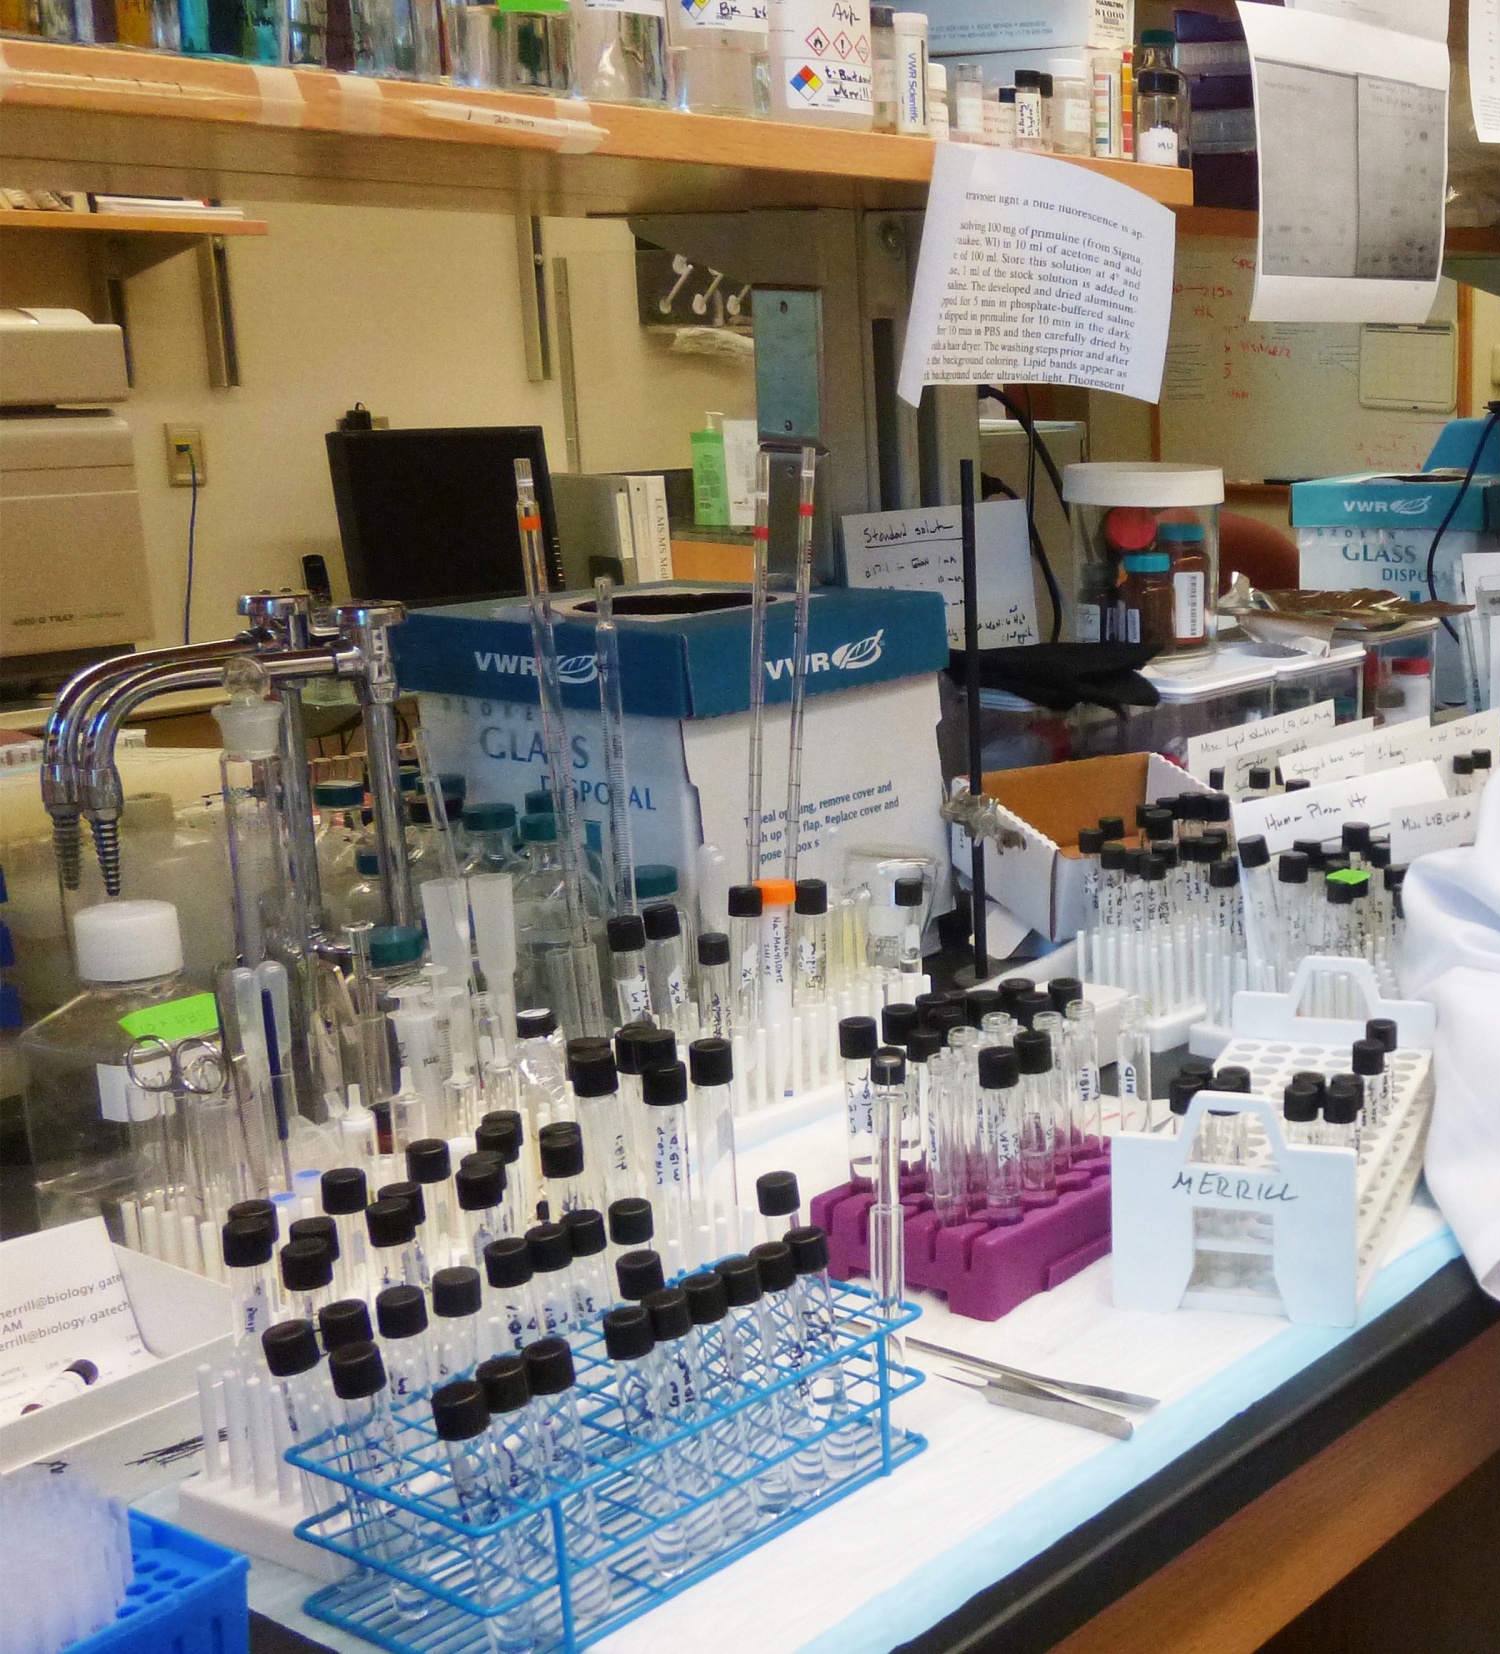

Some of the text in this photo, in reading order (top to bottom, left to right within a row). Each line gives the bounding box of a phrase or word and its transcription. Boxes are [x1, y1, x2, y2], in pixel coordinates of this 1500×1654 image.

[907, 52, 918, 123] VWR Scientific
[960, 221, 986, 234] solving
[988, 222, 1001, 232] 100
[1003, 226, 1016, 237] mg
[1019, 226, 1030, 235] of
[1031, 229, 1080, 244] primuline
[1083, 237, 1110, 253] (from
[956, 235, 982, 246] aukee,
[1003, 239, 1011, 248] in
[1016, 240, 1026, 249] 10
[1030, 242, 1042, 251] ml
[1046, 245, 1058, 254] of
[1061, 248, 1099, 263] acetone
[1103, 259, 1121, 270] and
[1124, 265, 1142, 277] add
[971, 251, 983, 261] 100
[1002, 253, 1025, 265] Store
[1029, 256, 1047, 267] this
[1051, 260, 1091, 275] solution
[1096, 270, 1105, 278] at
[1122, 278, 1141, 290] and
[971, 281, 986, 291] The
[988, 282, 1031, 296] developed
[1034, 287, 1051, 297] and
[1055, 287, 1081, 301] dried
[982, 267, 992, 277] of
[994, 267, 1006, 278] the
[1009, 269, 1034, 280] stock
[1038, 272, 1078, 286] solution
[1082, 280, 1090, 289] is
[1095, 284, 1125, 298] added
[1129, 292, 1139, 302] to
[944, 310, 968, 323] dipped
[970, 312, 977, 321] in
[980, 312, 1018, 324] primuline
[1021, 314, 1034, 324] for
[1038, 315, 1049, 326] 10
[1052, 317, 1071, 328] min
[1075, 321, 1084, 330] in
[1089, 323, 1104, 334] the
[960, 295, 970, 306] for
[981, 297, 995, 307] min
[999, 298, 1006, 307] in
[1010, 298, 1103, 319] phosphate-buffered
[1107, 314, 1136, 328] saline
[984, 326, 1000, 337] PBS
[1003, 327, 1019, 338] and
[1022, 328, 1041, 339] then
[1045, 332, 1086, 346] carefully
[1090, 337, 1116, 349] dried
[1120, 342, 1132, 355] by
[984, 341, 999, 351] The
[1001, 341, 1034, 355] washing
[1035, 346, 1058, 357] steps
[1059, 347, 1084, 358] prior
[1085, 351, 1104, 361] and
[1105, 353, 1130, 366] after
[931, 370, 970, 382] background
[973, 370, 994, 380] under
[996, 370, 1039, 381] ultraviolet
[1068, 373, 1125, 391] Fluorescent
[942, 355, 983, 368] background
[986, 355, 1020, 368] coloring.
[1023, 357, 1046, 369] Lipid
[1050, 358, 1077, 370] bands
[1080, 364, 1115, 376] appear
[1116, 370, 1127, 378] as
[1343, 501, 1388, 513] VWR
[1342, 543, 1416, 564] GLASS
[473, 651, 541, 677] VWR
[479, 726, 590, 769] GLAS
[819, 794, 850, 809] remove
[852, 786, 875, 800] cover
[877, 780, 892, 794] and
[770, 797, 899, 844] up flap. Replace cover and
[1172, 1171, 1299, 1201] MERRILL
[2, 1320, 23, 1335] AM
